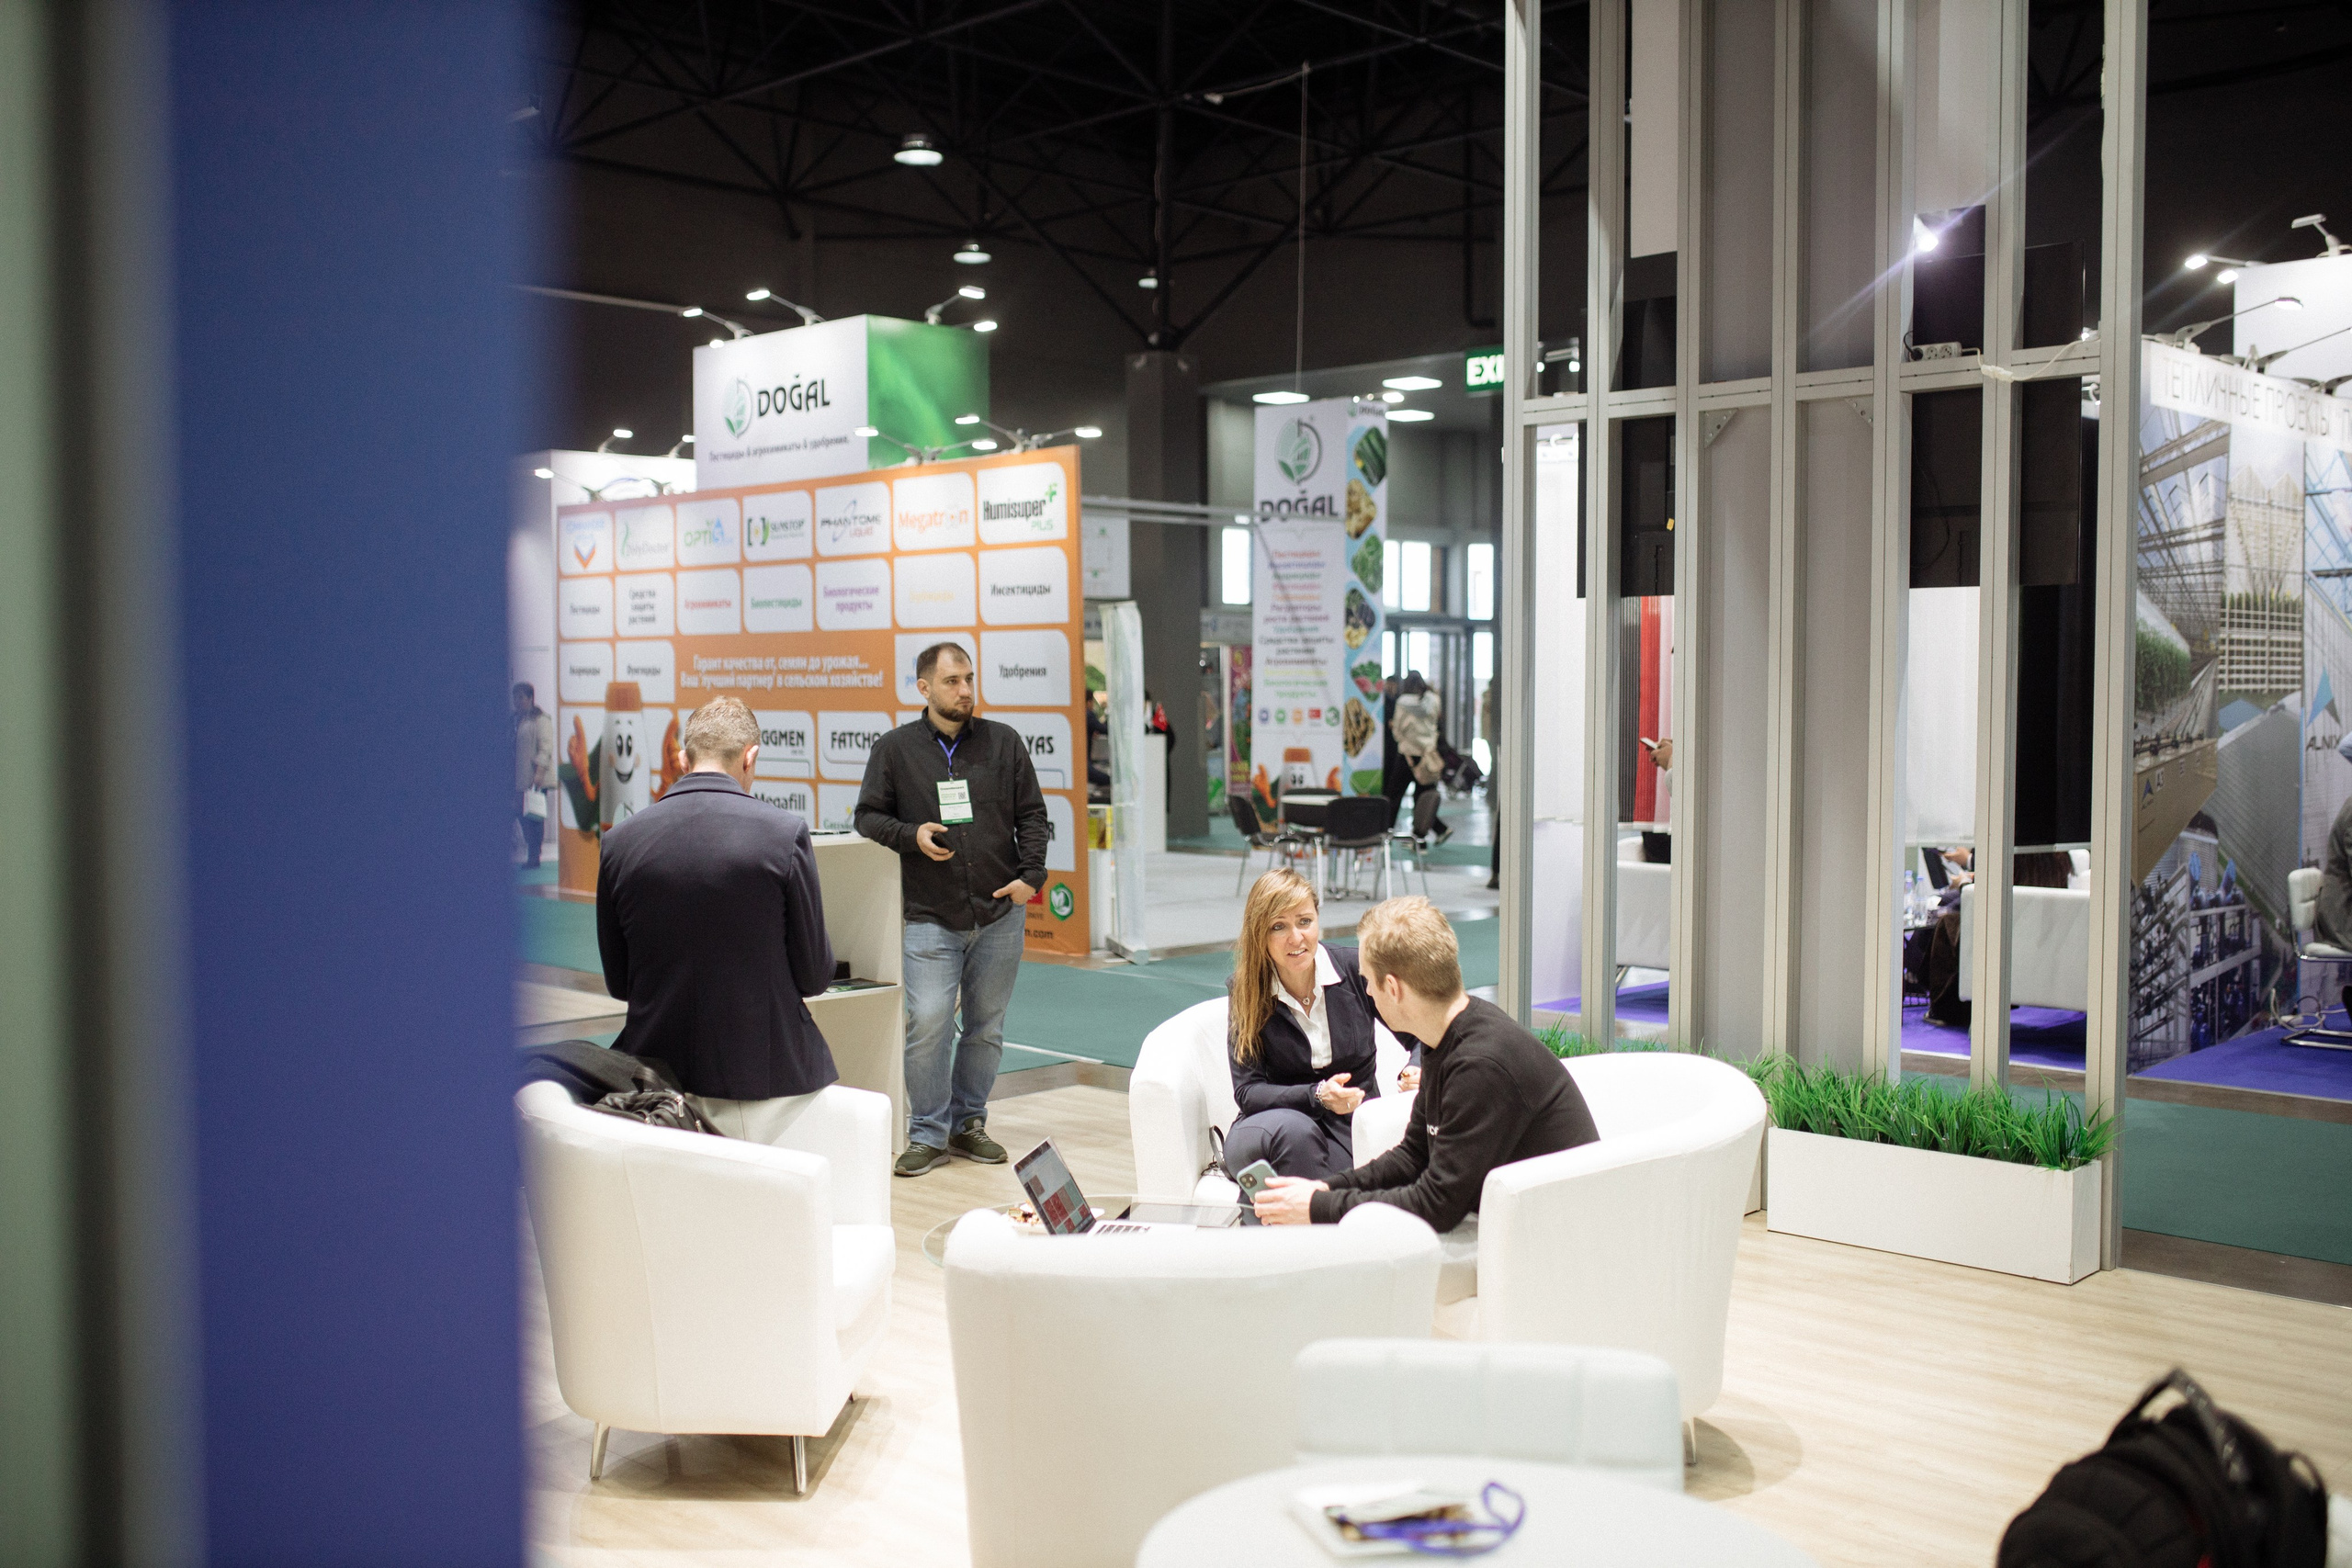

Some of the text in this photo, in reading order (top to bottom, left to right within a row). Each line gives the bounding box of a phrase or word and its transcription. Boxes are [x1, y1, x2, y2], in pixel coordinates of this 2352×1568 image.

[1466, 355, 1504, 386] EXI
[758, 374, 831, 417] DOĞAL
[2163, 357, 2260, 420] ТЕПЛИЧНЫЕ
[2266, 385, 2331, 436] ПРОЕКТЫ
[1261, 490, 1338, 523] DOĞAL
[990, 584, 1051, 597] Инсектициды
[999, 664, 1046, 679] Удобрения
